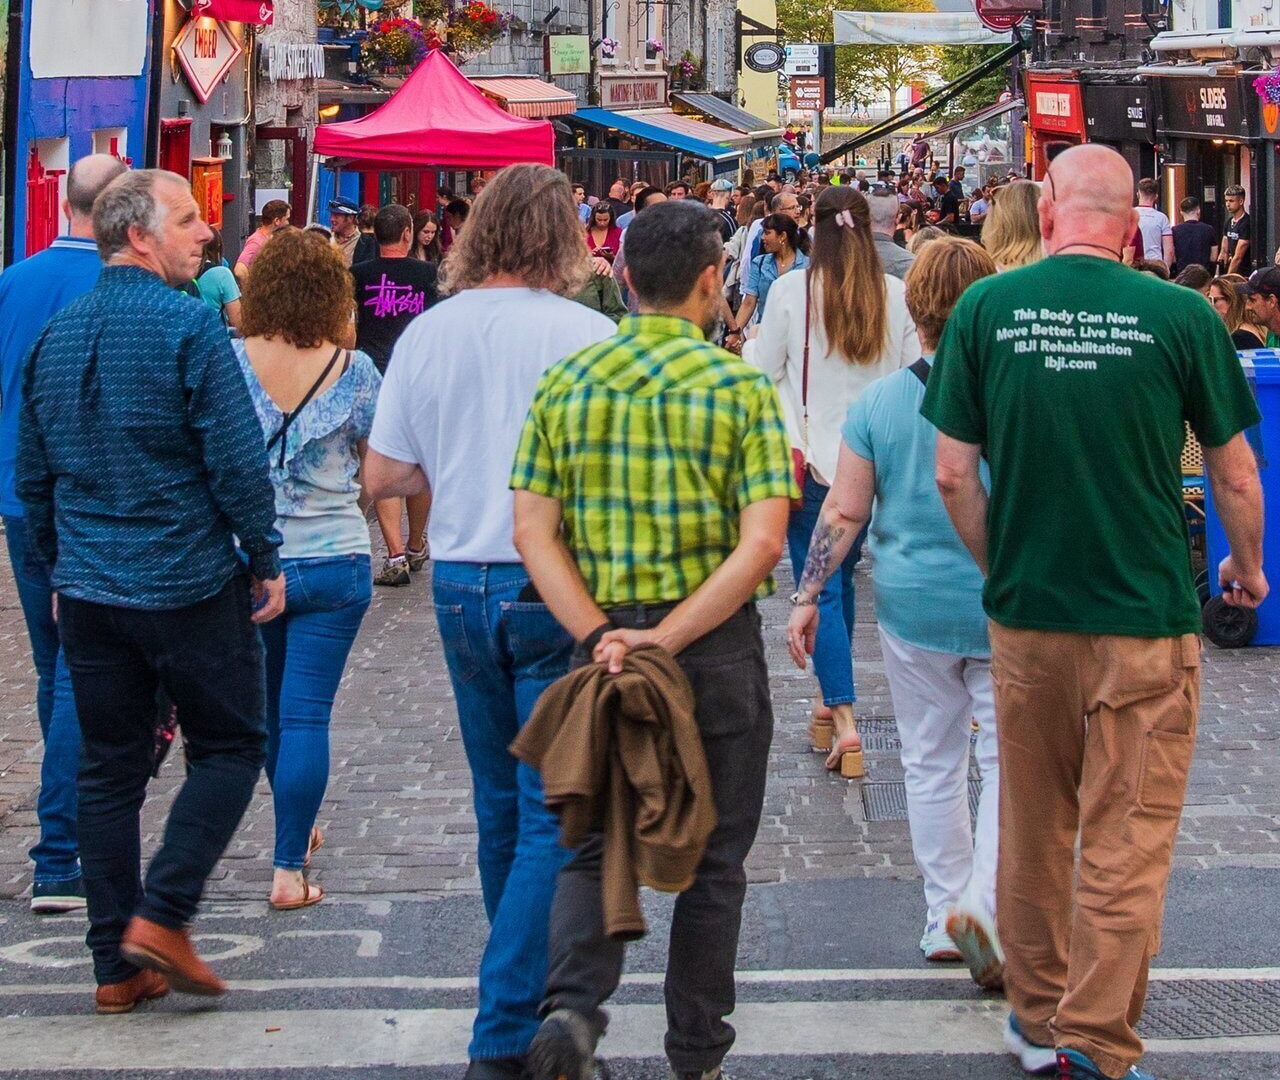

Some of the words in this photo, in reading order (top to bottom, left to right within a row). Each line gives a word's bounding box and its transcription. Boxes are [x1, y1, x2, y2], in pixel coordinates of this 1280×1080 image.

[194, 28, 217, 58] EMBER
[1200, 87, 1227, 109] SLIDERS
[1127, 106, 1143, 119] SNUG
[1013, 308, 1037, 321] This
[1040, 308, 1074, 325] Body
[1077, 311, 1103, 324] Can
[1106, 312, 1139, 325] Now
[996, 326, 1028, 341] Move
[1031, 323, 1076, 338] Better.
[1080, 326, 1107, 339] Live
[1110, 327, 1155, 344] Better.
[1014, 340, 1037, 354] IBJI
[1040, 340, 1132, 356] Rehabilitation
[1044, 356, 1097, 371] ibji.com
